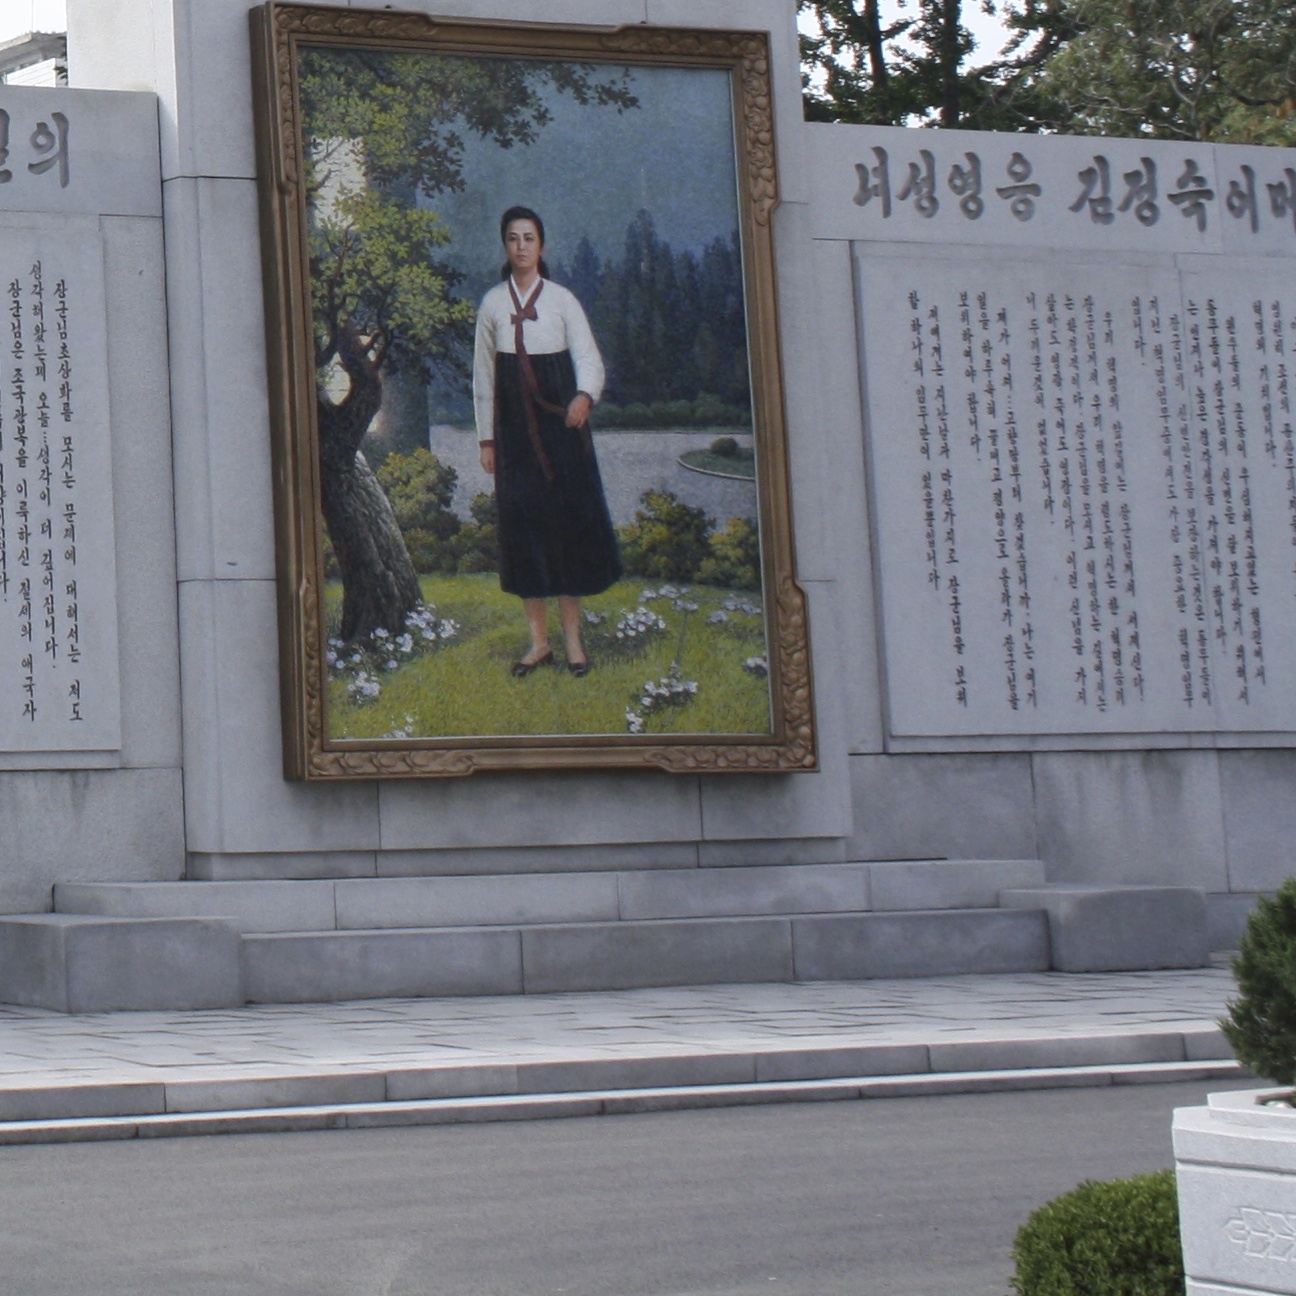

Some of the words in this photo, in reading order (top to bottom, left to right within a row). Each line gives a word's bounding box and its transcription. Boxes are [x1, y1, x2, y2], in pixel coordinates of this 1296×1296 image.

[852, 145, 1043, 222] 녀성영웅
[7, 278, 24, 356] 장군님은
[11, 368, 28, 468] 조국광복을
[61, 436, 76, 489] 모시는
[63, 503, 76, 566] 문제에
